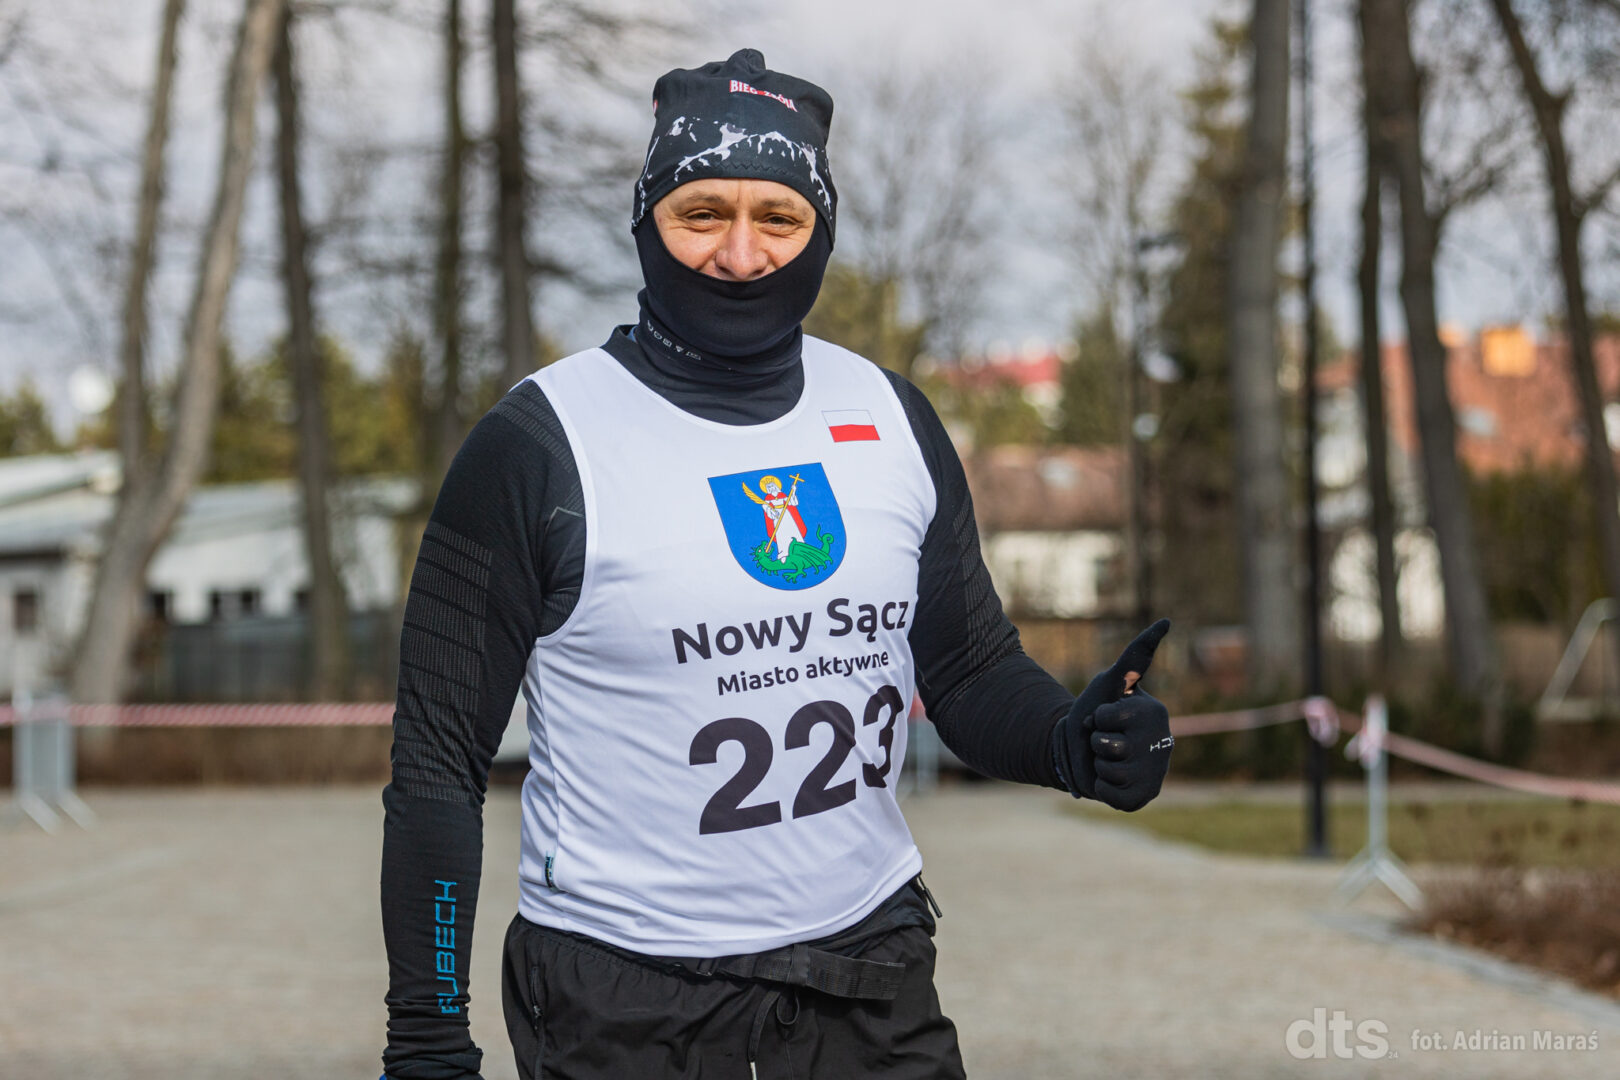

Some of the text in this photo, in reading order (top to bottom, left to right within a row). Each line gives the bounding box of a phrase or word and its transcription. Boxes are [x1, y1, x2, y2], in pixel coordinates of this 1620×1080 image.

[729, 79, 758, 95] BIEG
[671, 597, 909, 664] Nowy Sącz
[717, 649, 889, 696] Miasto aktywne
[688, 684, 904, 835] 223
